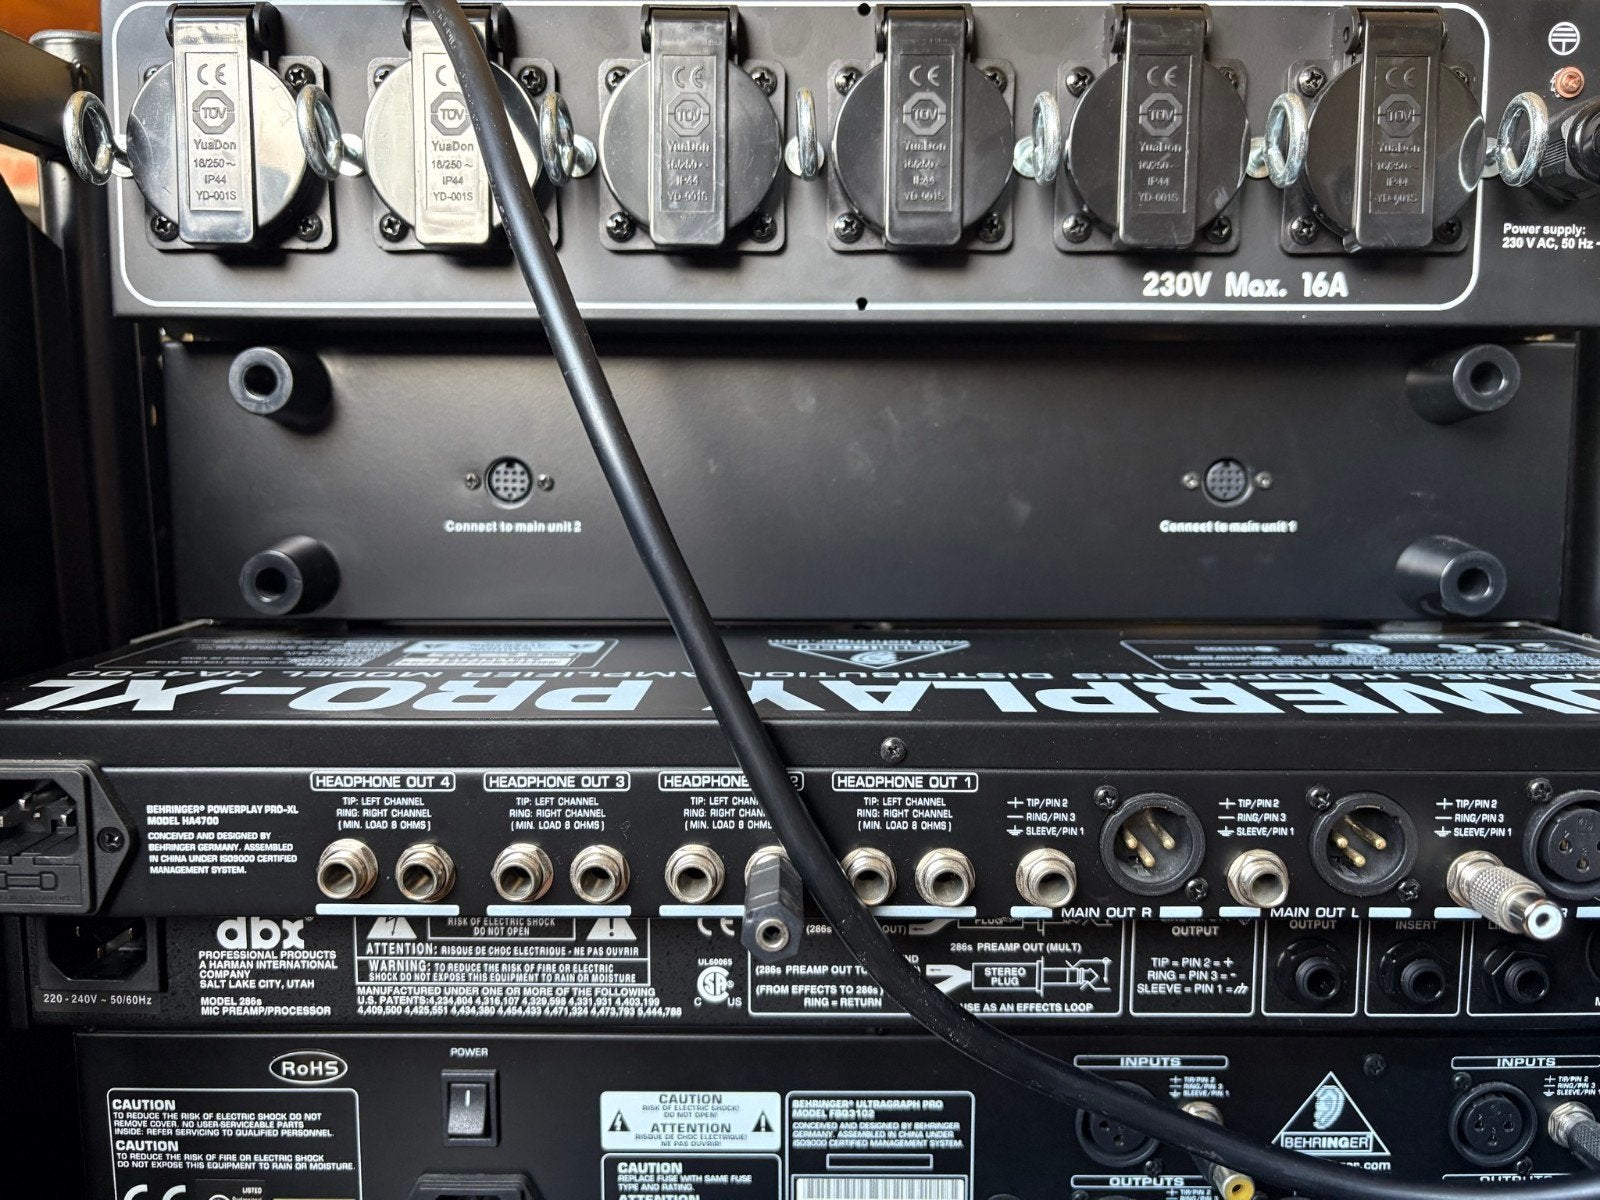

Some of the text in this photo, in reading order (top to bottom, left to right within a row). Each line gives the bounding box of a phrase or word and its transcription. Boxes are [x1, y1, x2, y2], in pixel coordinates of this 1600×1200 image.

[431, 140, 475, 152] YuaDon
[204, 174, 227, 185] IP44
[442, 176, 464, 186] IP44
[195, 190, 237, 201] YD-001S
[433, 191, 474, 202] YD-001S
[1503, 222, 1586, 238] Power supply:
[1501, 236, 1594, 251] 230 V AC, 50 Hz
[1142, 271, 1350, 298] 230V Max. 16A
[444, 519, 582, 533] Connect to main unit 2
[1159, 519, 1298, 533] Connect to main unit 1
[283, 670, 443, 678] MODEL
[5, 679, 653, 712] PRO-XL
[315, 775, 451, 788] HEADPHONE OUT 4
[489, 775, 625, 788] HEADPHONE OUT 3
[663, 775, 750, 788] HEADPHONE
[837, 776, 972, 789] HEADPHONE OUT 1
[342, 796, 425, 806] TIP: LEFT CHANNEL
[1026, 798, 1068, 809] TIP/PIN 2
[207, 804, 263, 814] POWERPLAY
[264, 804, 299, 814] PRO-XL
[336, 808, 432, 818] RING: RIGHT CHANNEL
[147, 816, 219, 826] MODEL HA4700
[1026, 812, 1076, 823] RING/PIN 3
[365, 820, 388, 830] LOAD
[391, 820, 398, 830] 8
[148, 831, 272, 841] CONCEIVED AND DESIGNED BY
[1025, 826, 1085, 837] SLEEVE/PIN 1
[148, 843, 293, 852] BEHRINGER GERMANY. ASSEMBLED
[149, 854, 159, 863] IN
[160, 854, 187, 863] CHINA
[188, 854, 218, 863] UNDER
[257, 854, 298, 863] CERTIFIED
[150, 865, 247, 874] MANAGEMENT SYSTEM.
[1061, 907, 1152, 918] MAIN OUT R
[1270, 907, 1359, 918] MAIN OUT L
[1289, 919, 1338, 930] OUTPUT
[1395, 920, 1439, 931] INSERT
[216, 916, 305, 950] dbx
[1171, 925, 1219, 937] OUTPUT
[366, 942, 438, 955] ATTENTION:
[950, 942, 1082, 953] 286s PREAMP OUT (MULT)
[198, 950, 337, 961] PROFESSIONAL PRODUCTS
[199, 960, 338, 970] A HARMAN INTERNATIONAL
[369, 959, 431, 972] WARNING:
[697, 957, 733, 967] UL60065
[199, 970, 251, 980] COMPANY
[984, 967, 1027, 977] STEREO
[200, 979, 315, 991] SALT LAKE CITY, UTAH
[990, 977, 1020, 987] PLUG
[357, 986, 656, 997] MANUFACTURED UNDER ONE OR MORE OF THE FOLLOWING
[43, 994, 153, 1005] 220 240V 50/60Hz
[200, 996, 262, 1006] MODEL 286s
[201, 1006, 331, 1016] MIC PREAMP/PROCESSOR
[449, 1047, 489, 1058] POWER
[1120, 1056, 1182, 1067] INPUTS
[1496, 1057, 1556, 1068] INPUTS
[281, 1060, 340, 1077] RoHS
[658, 1093, 723, 1105] CAUTION
[112, 1099, 176, 1111] CAUTION
[855, 1099, 921, 1111] ULTRAGRAPH
[922, 1100, 944, 1111] PRO
[113, 1111, 322, 1121] TO REDUCE THE RISK OF ELECTRIC SHOCK DO NOT
[792, 1109, 828, 1120] MODEL
[651, 1122, 732, 1134] ATTENTION
[115, 1140, 179, 1152] CAUTION
[1284, 1136, 1369, 1149] BEHRINGER
[617, 1162, 683, 1175] CAUTION
[1109, 1176, 1185, 1187] OUTPUTS
